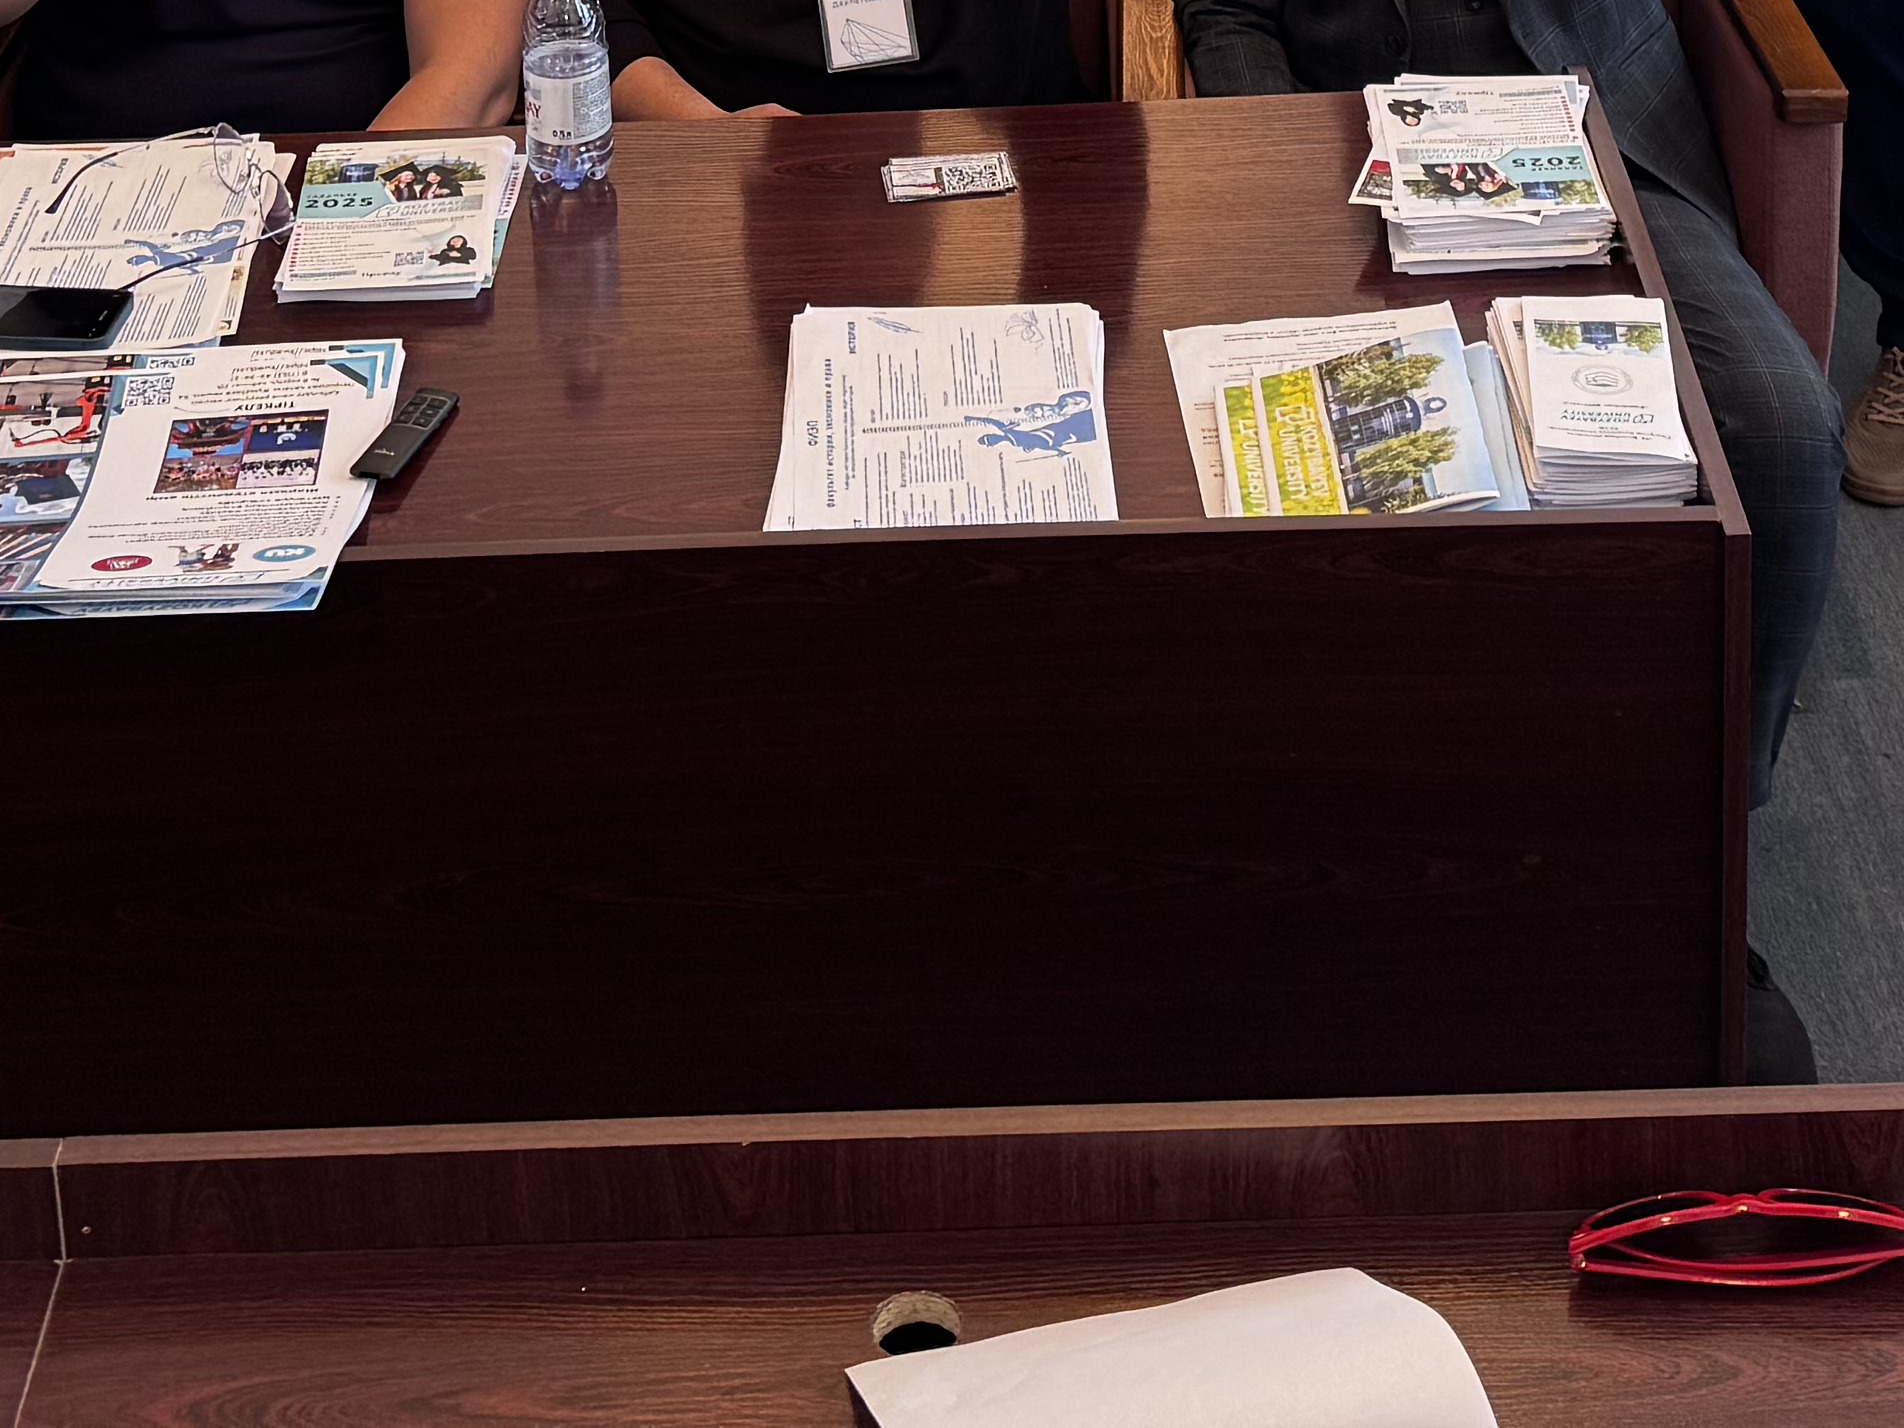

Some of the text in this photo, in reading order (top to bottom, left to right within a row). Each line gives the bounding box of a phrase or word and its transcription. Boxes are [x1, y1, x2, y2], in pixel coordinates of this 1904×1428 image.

[1512, 156, 1581, 168] 2025
[305, 197, 373, 209] 2025
[1279, 429, 1309, 501] UNIVERSITY
